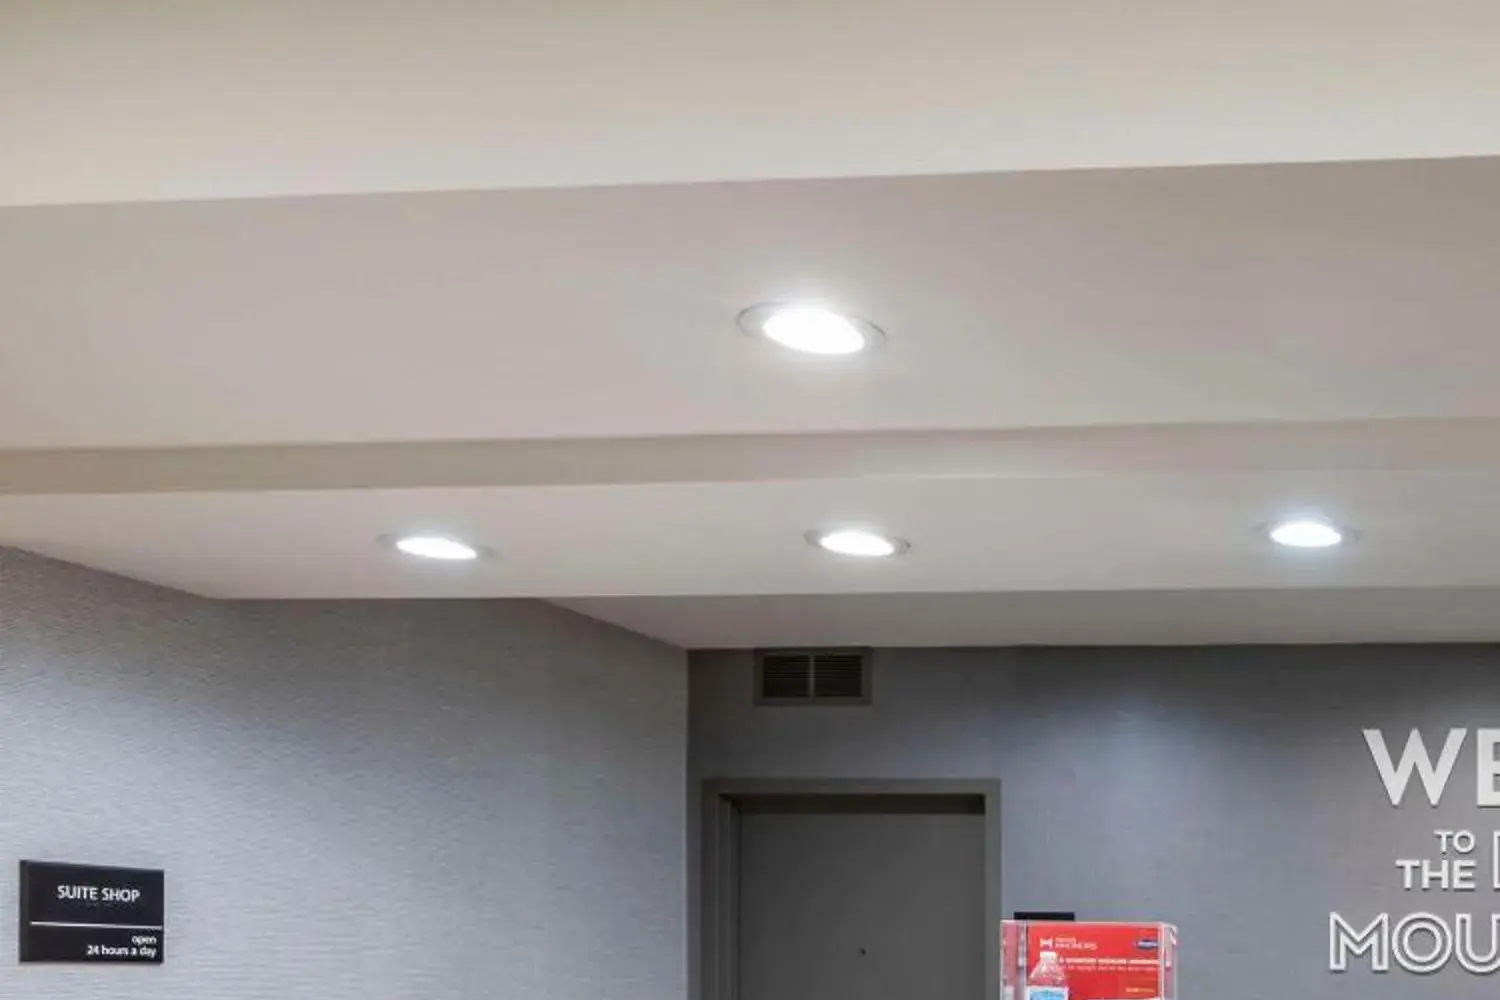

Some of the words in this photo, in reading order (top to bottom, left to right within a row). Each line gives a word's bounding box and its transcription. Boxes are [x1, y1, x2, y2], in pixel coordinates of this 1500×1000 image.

[1435, 831, 1474, 853] TO
[1396, 859, 1476, 890] THE
[57, 884, 99, 900] SUITE
[101, 887, 141, 902] SHOP
[131, 935, 157, 945] open
[87, 945, 99, 956] 24
[101, 945, 129, 956] hours
[139, 945, 157, 958] day
